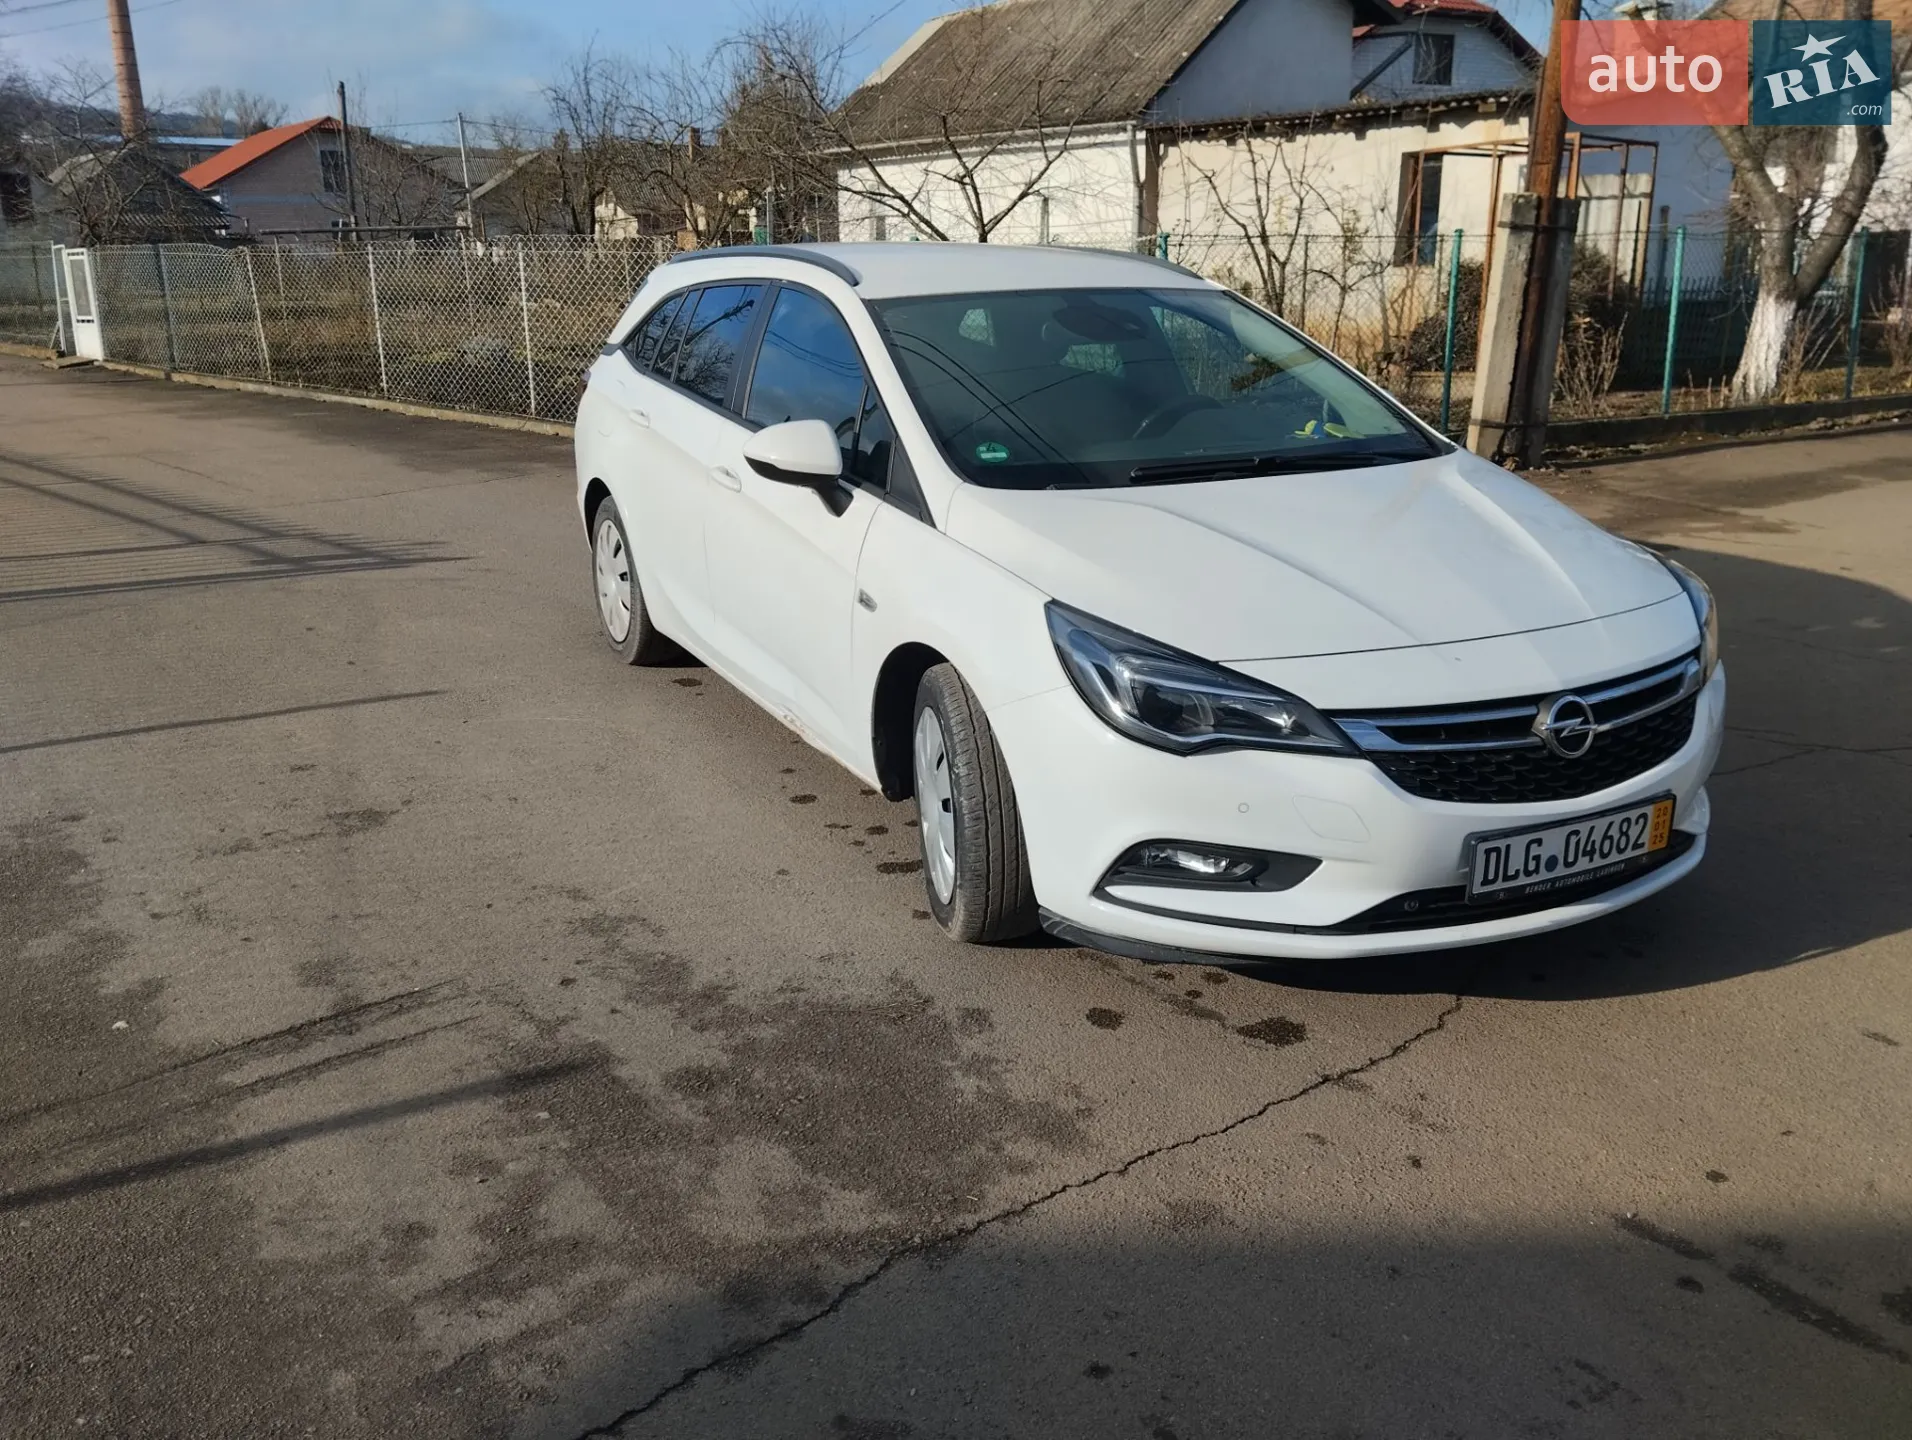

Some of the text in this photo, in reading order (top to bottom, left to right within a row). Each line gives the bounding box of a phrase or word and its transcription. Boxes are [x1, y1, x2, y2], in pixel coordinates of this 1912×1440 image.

[986, 442, 997, 452] 4
[1480, 812, 1649, 887] DLG 04682
